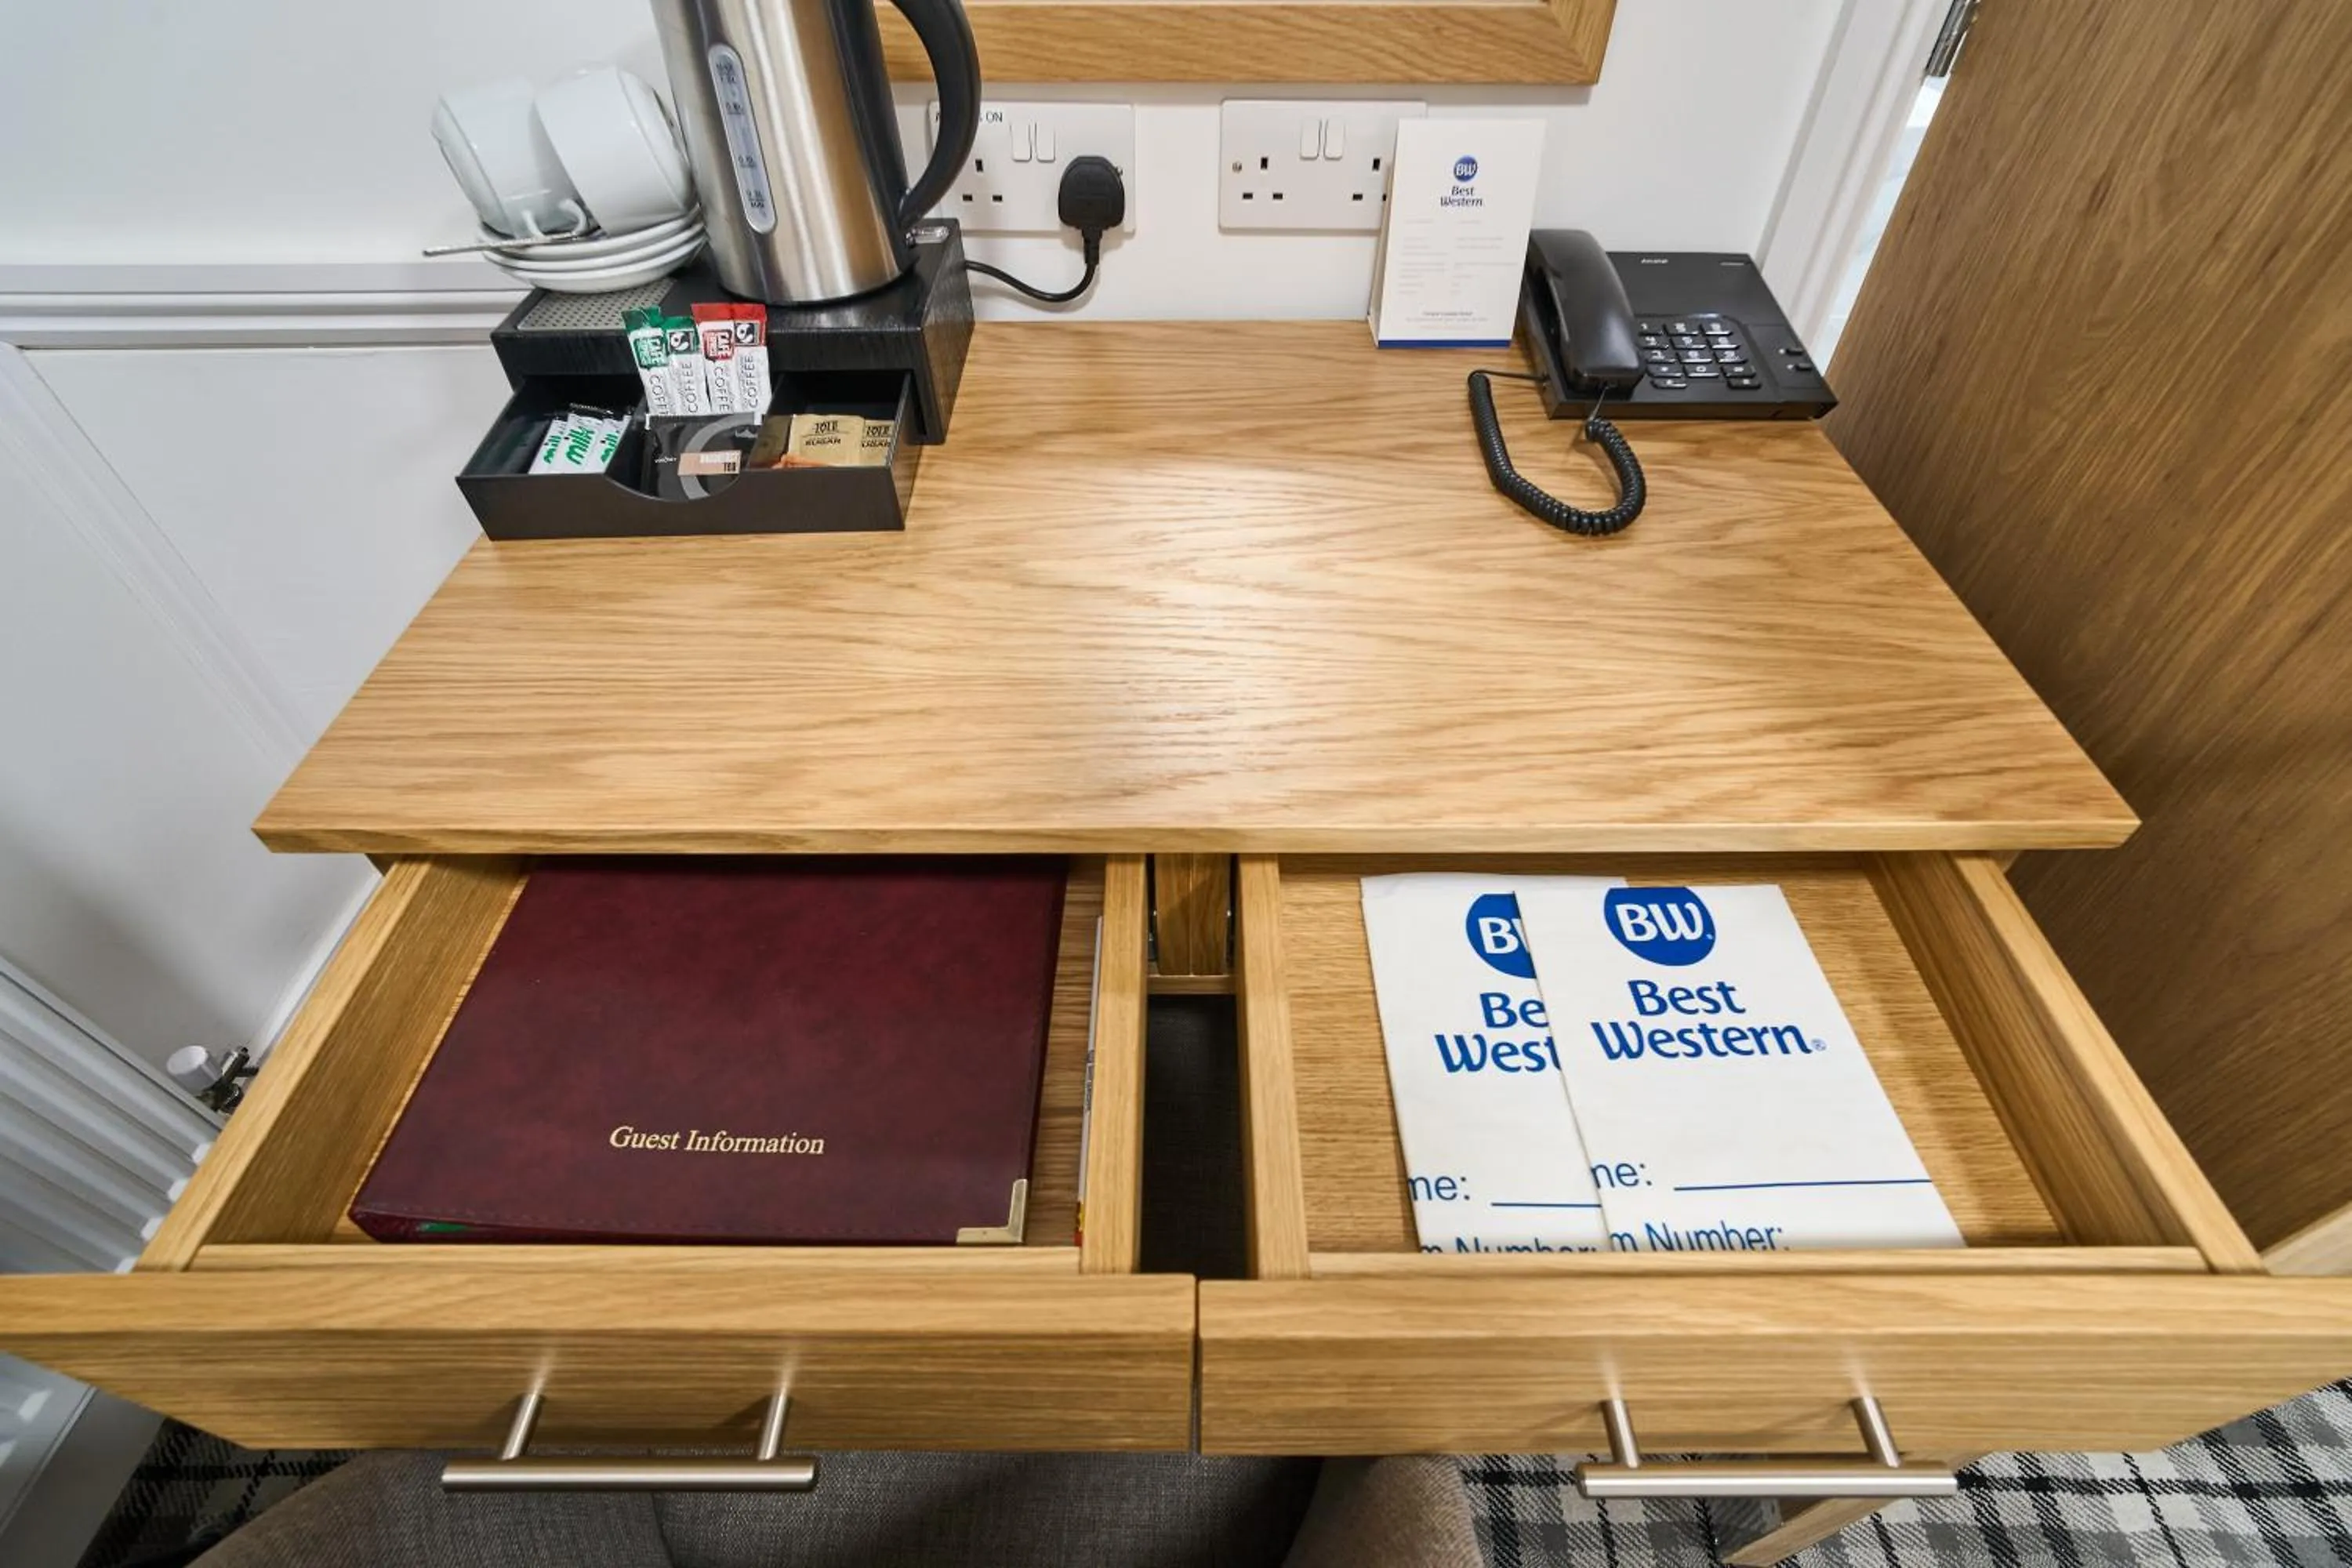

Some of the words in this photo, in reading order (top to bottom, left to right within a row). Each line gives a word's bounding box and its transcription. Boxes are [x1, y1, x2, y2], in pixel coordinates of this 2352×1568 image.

[985, 111, 1003, 123] ON
[1455, 162, 1476, 176] BW
[1440, 196, 1483, 208] Western
[1451, 185, 1475, 196] Best
[682, 361, 699, 413] COFFEE
[714, 366, 731, 412] COFFE
[745, 354, 758, 408] COFFEE
[543, 434, 563, 464] mil
[564, 425, 595, 465] milk
[600, 430, 620, 463] mil
[1478, 916, 1530, 954] B
[1615, 902, 1704, 942] BW
[1479, 991, 1550, 1029] Be
[1628, 979, 1746, 1016] Best
[1434, 1033, 1563, 1073] West
[609, 1125, 681, 1150] Guest
[684, 1129, 825, 1155] Information
